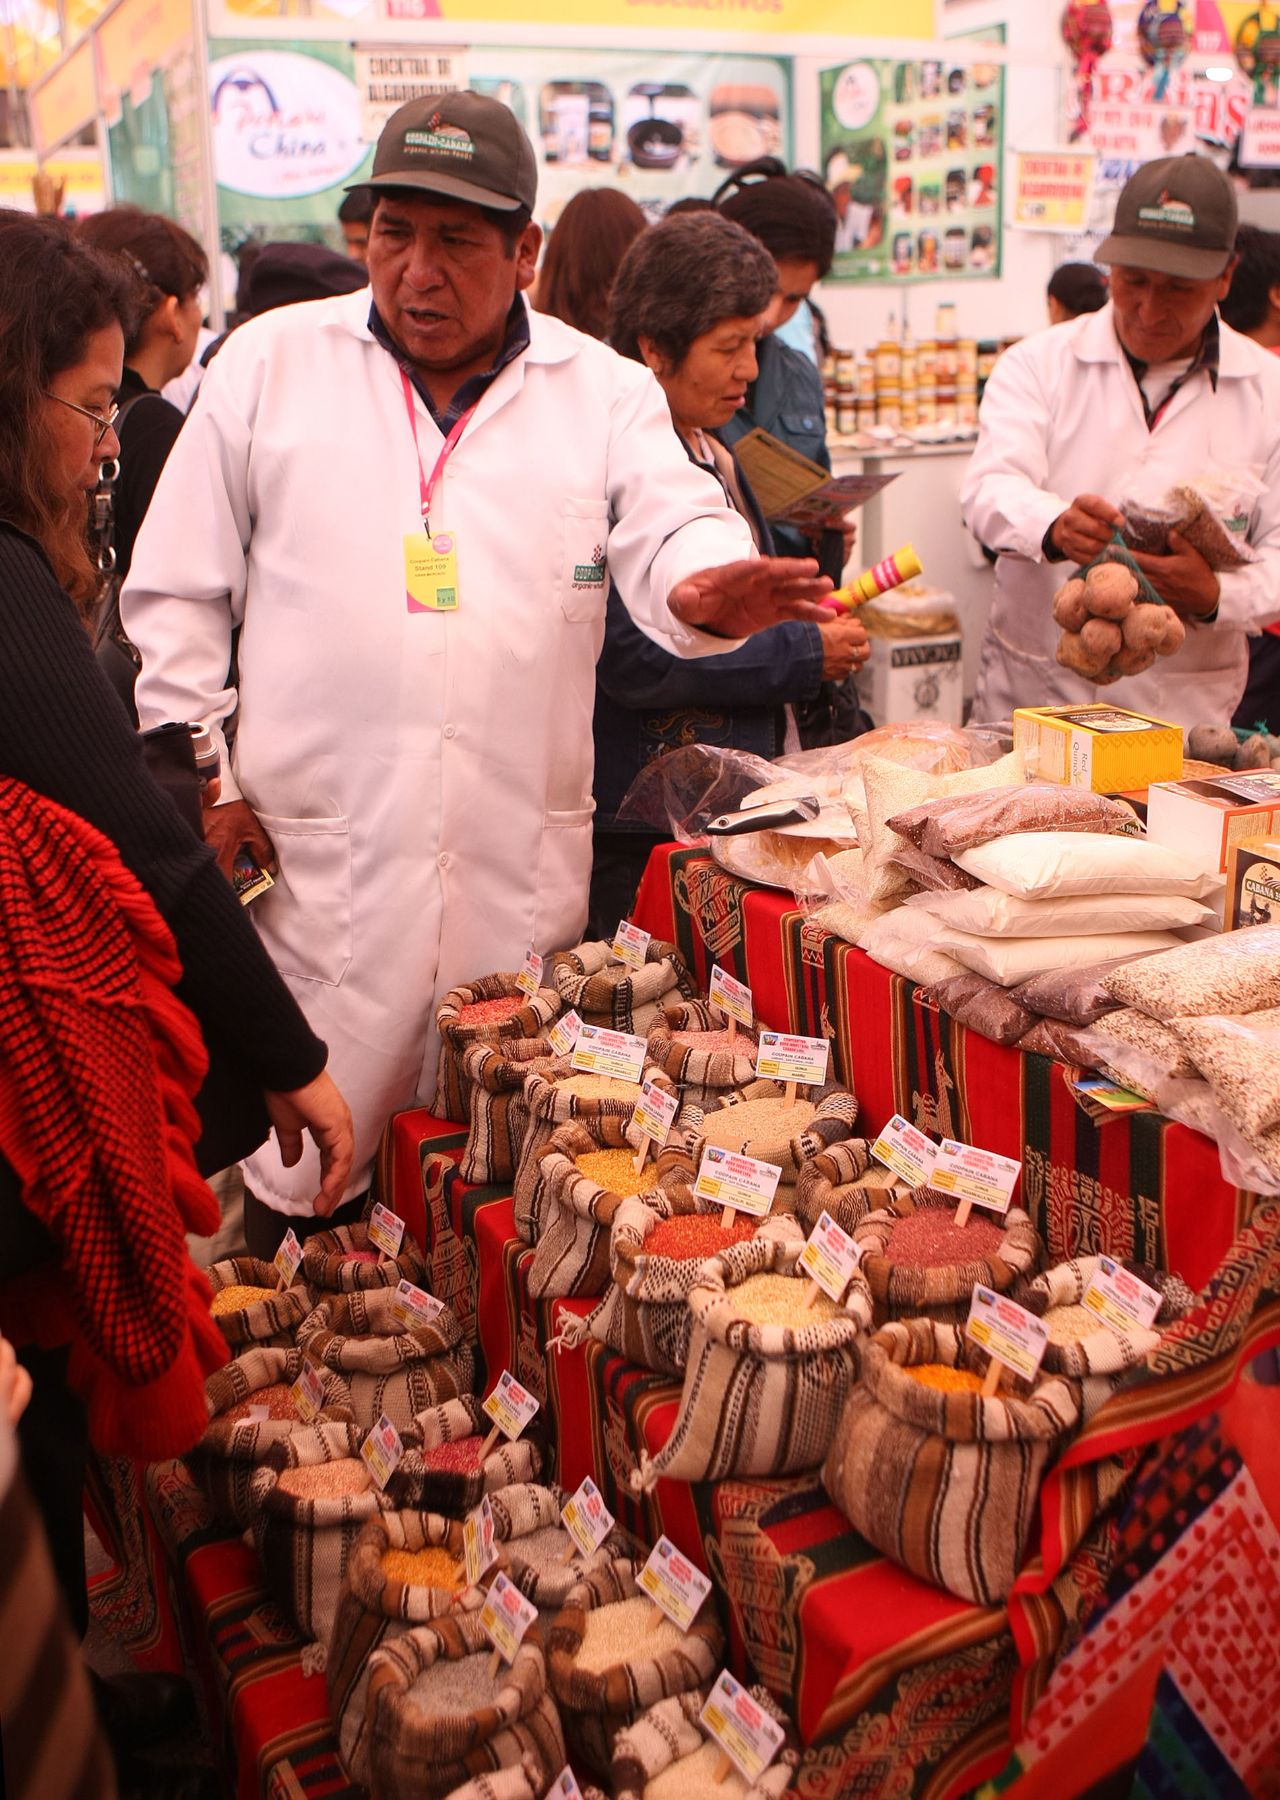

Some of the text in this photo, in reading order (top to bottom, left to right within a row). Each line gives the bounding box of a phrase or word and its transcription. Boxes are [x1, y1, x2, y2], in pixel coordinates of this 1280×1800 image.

[1246, 880, 1275, 900] CABANA
[714, 1170, 738, 1181] COOPAIN
[738, 1177, 760, 1188] CABANA
[974, 1171, 998, 1182] CABANA
